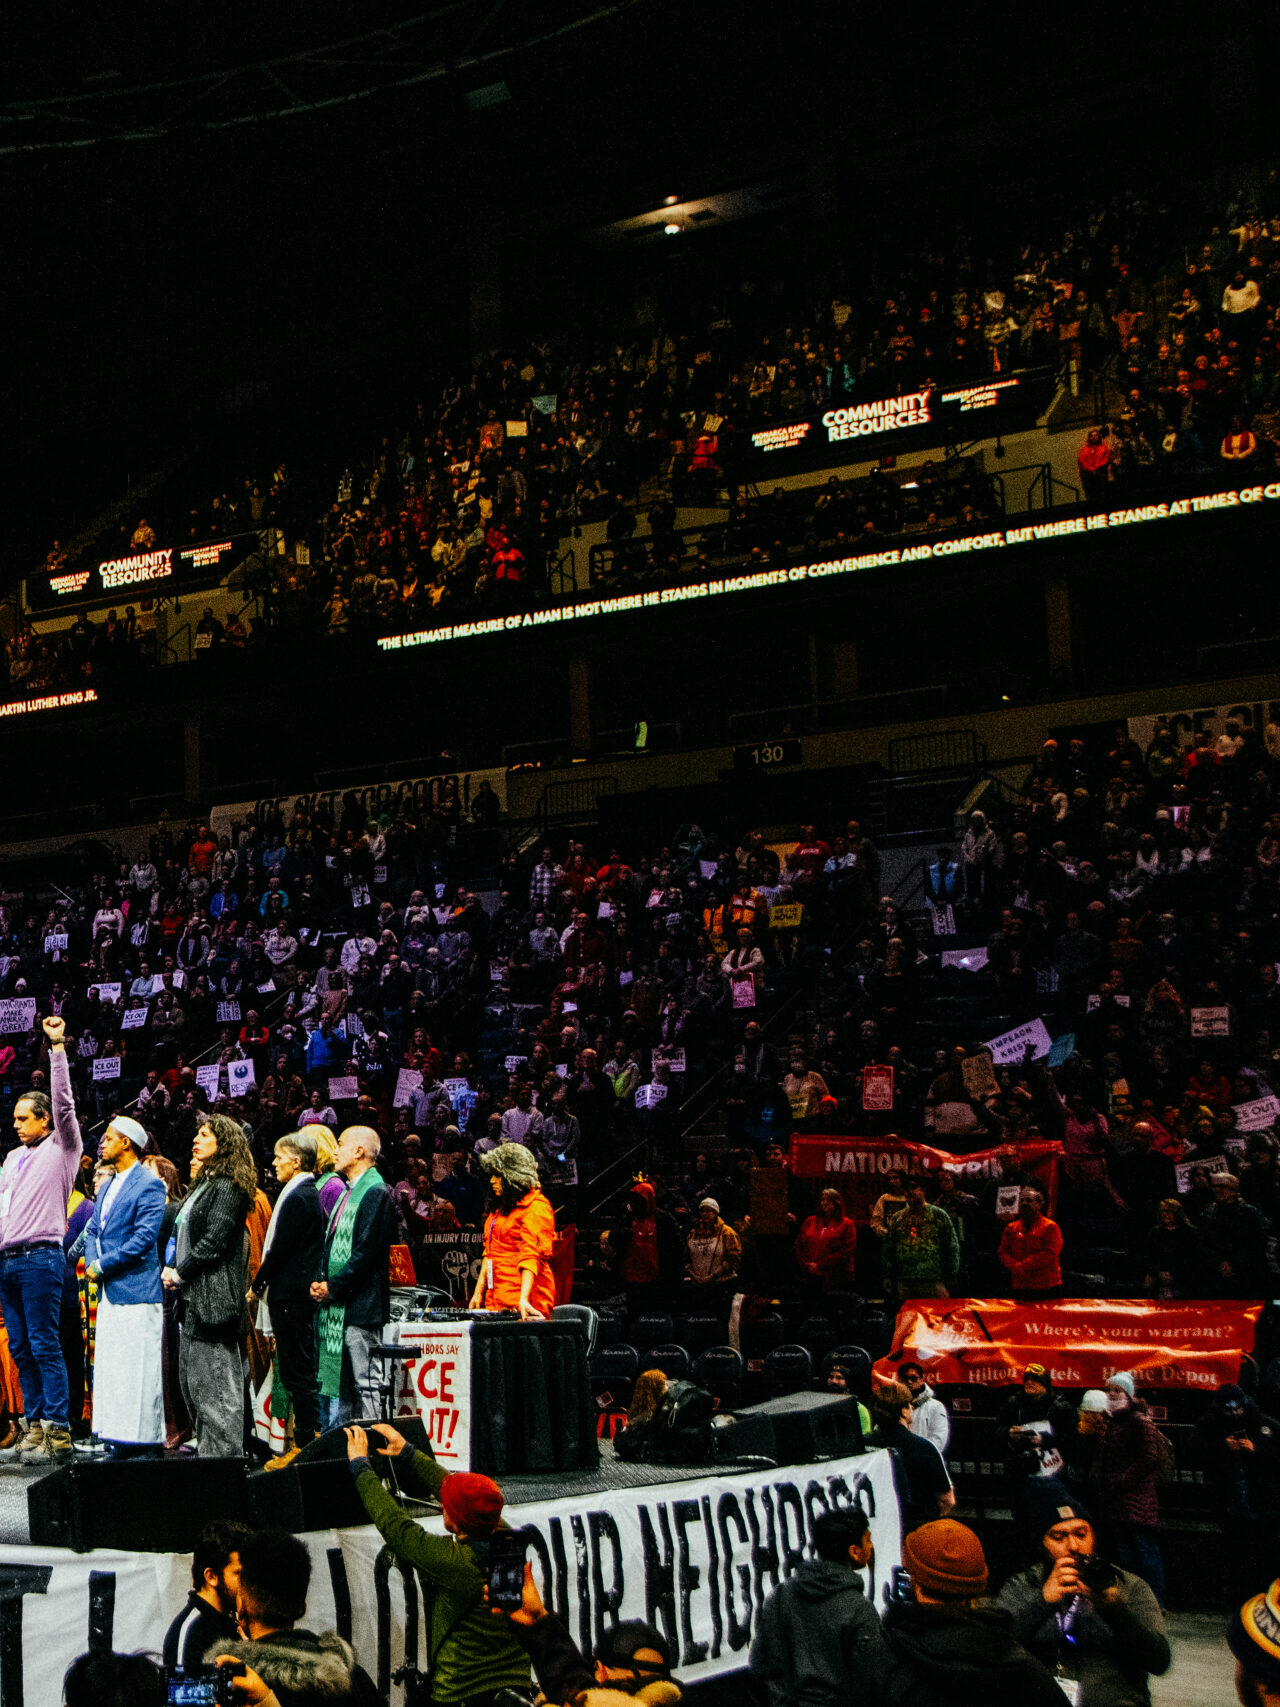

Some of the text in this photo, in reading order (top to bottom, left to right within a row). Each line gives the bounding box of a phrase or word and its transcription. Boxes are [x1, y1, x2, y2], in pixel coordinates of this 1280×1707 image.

[822, 391, 931, 427] COMMUNITY
[828, 407, 932, 442] RESOURCES
[99, 548, 173, 576] COMMUNITY
[402, 626, 452, 647] ULTIMATE
[453, 617, 504, 638] MEASURE
[505, 615, 521, 629] OF
[522, 613, 532, 626] A
[533, 608, 561, 624] MAN
[563, 606, 574, 620] IS
[575, 601, 600, 617] NOT
[601, 594, 642, 613] WHERE
[643, 591, 660, 606] HE
[661, 583, 708, 603] STANDS
[709, 580, 723, 595] IN
[724, 569, 788, 592] MOMENTS
[789, 565, 808, 581] OF
[808, 549, 900, 577] CONVENIENCE
[901, 545, 932, 562] AND
[933, 532, 1006, 556] COMFORT,
[1006, 526, 1034, 544] BUT
[1034, 517, 1087, 539] WHERE
[1087, 513, 1109, 530] HE
[1109, 503, 1170, 526] STANDS
[1170, 499, 1191, 516] AT
[1192, 490, 1240, 511] TIMES
[1240, 486, 1263, 503] OF
[102, 562, 173, 589] RESOURCES
[27, 695, 59, 712] LUTHER
[60, 691, 83, 706] KING
[84, 689, 97, 702] JR.
[752, 745, 783, 765] 130
[3, 1009, 23, 1017] MAKE
[2, 1023, 26, 1032] GREAT
[990, 1027, 1033, 1050] IMPEACH
[106, 1061, 119, 1069] OUT
[1251, 1102, 1275, 1115] OUT
[423, 1234, 433, 1244] AN
[434, 1233, 459, 1244] INJURY
[460, 1233, 470, 1243] TO
[1024, 1322, 1233, 1340] Where's your warrant?
[446, 1345, 459, 1355] SAY
[399, 1359, 454, 1403] ICE
[969, 1367, 1017, 1385] Hilton
[1050, 1367, 1080, 1381] tels
[1161, 1366, 1218, 1386] Depot
[398, 1405, 459, 1449] UT!
